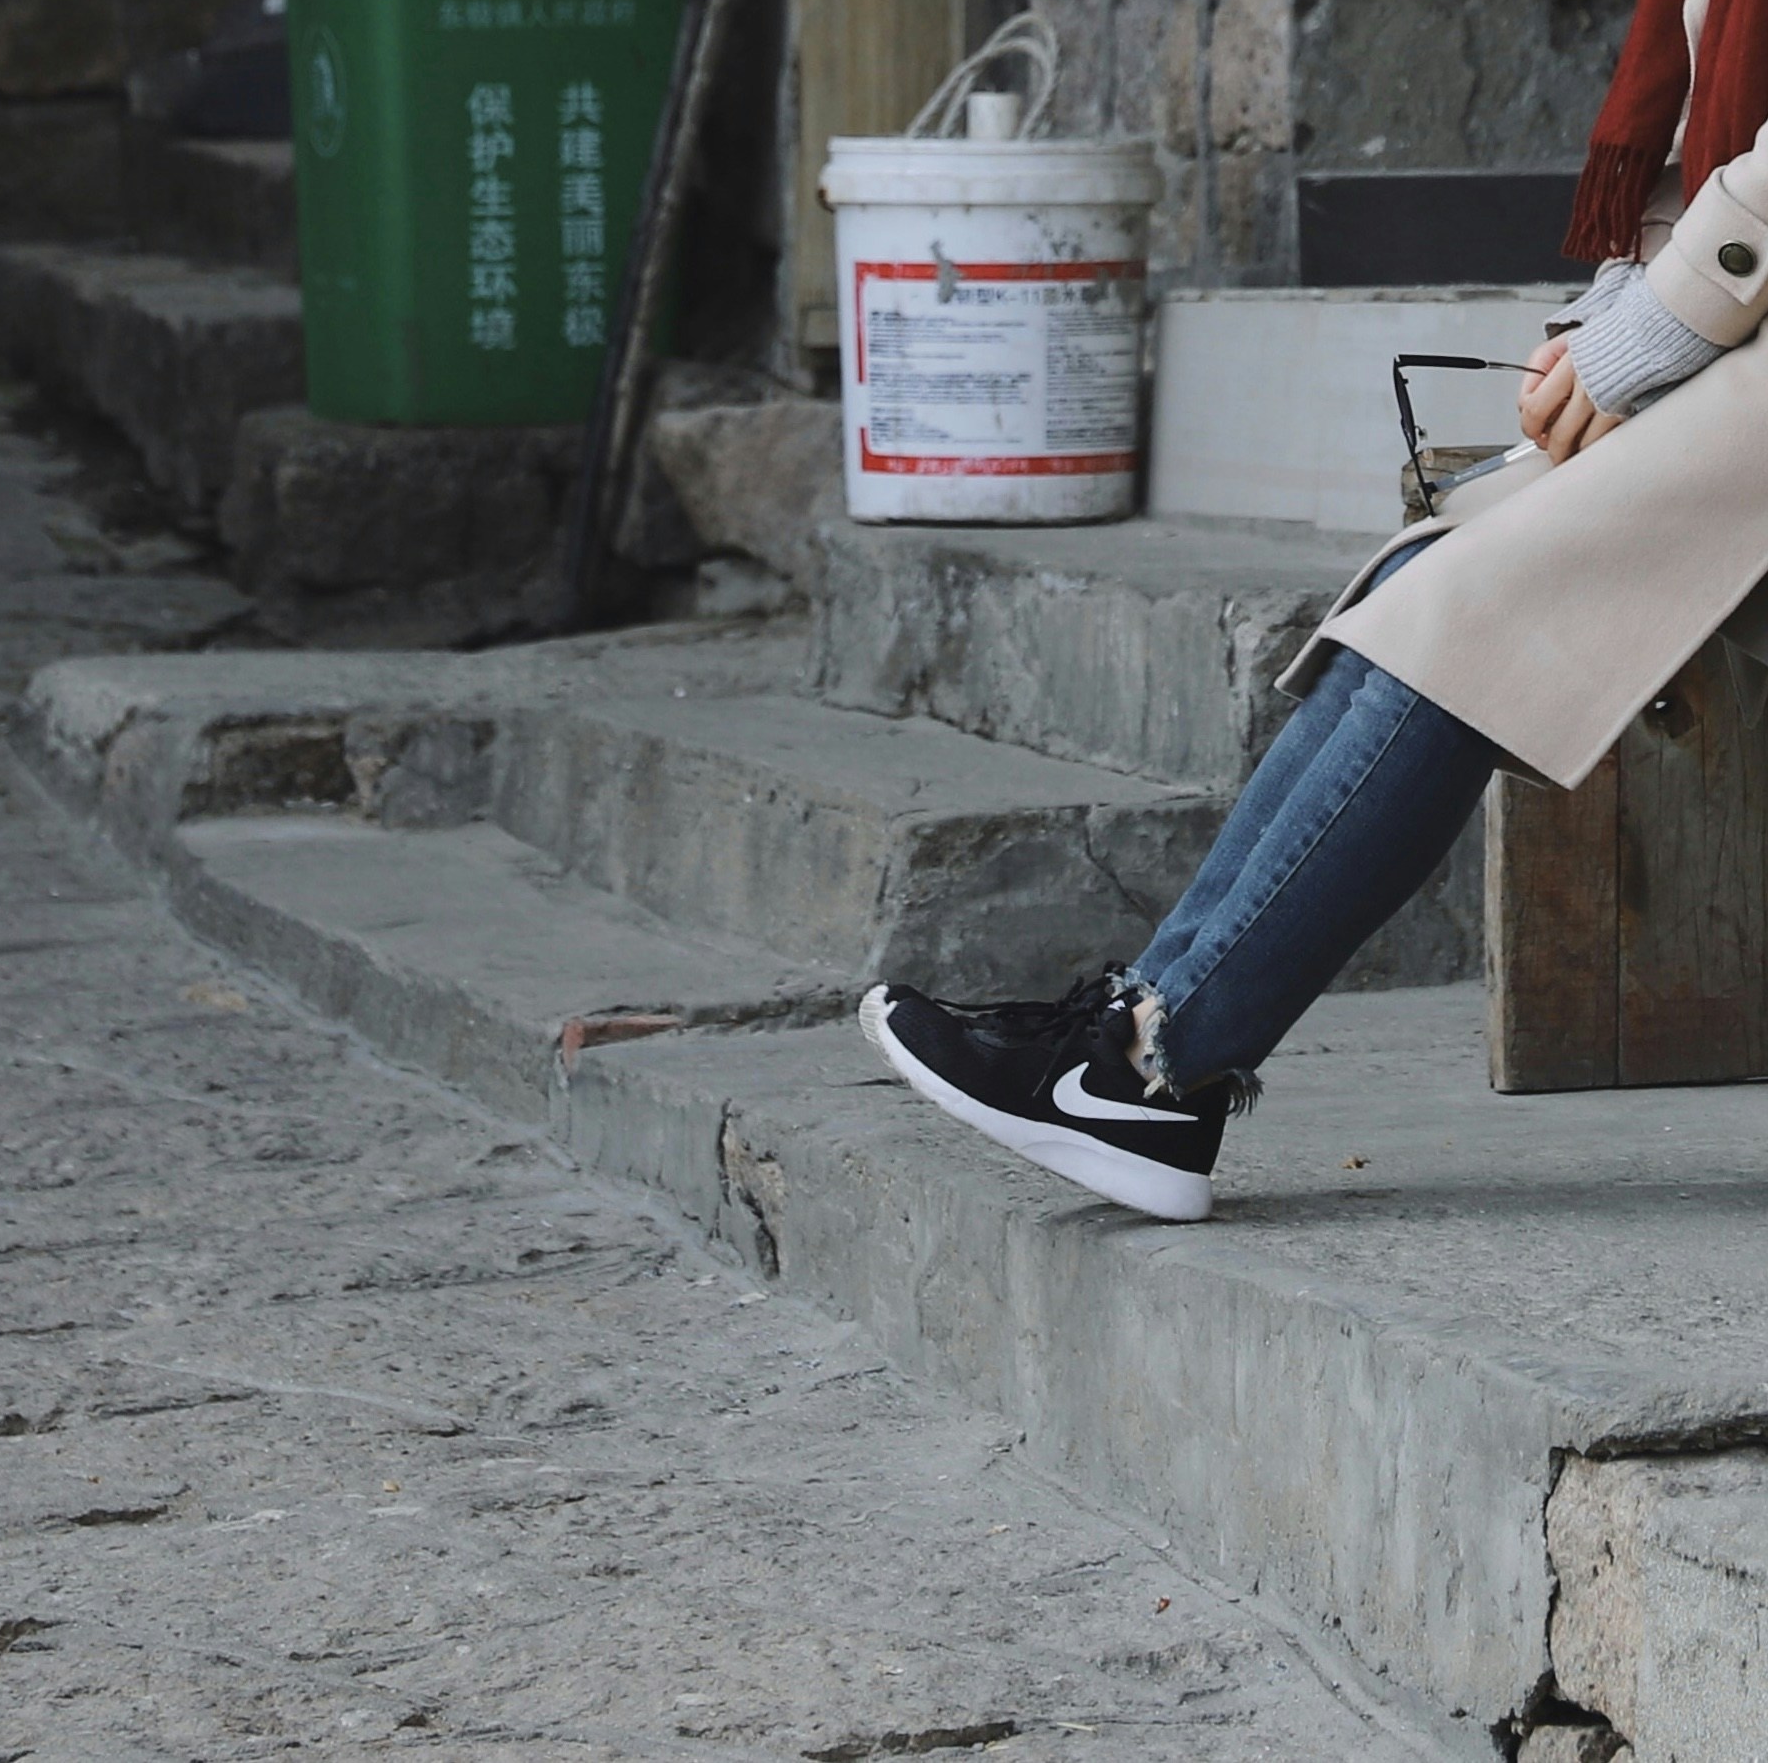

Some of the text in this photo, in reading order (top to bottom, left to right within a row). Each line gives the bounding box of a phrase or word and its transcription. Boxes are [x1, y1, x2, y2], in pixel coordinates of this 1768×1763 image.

[466, 81, 517, 350] 保护生态环境
